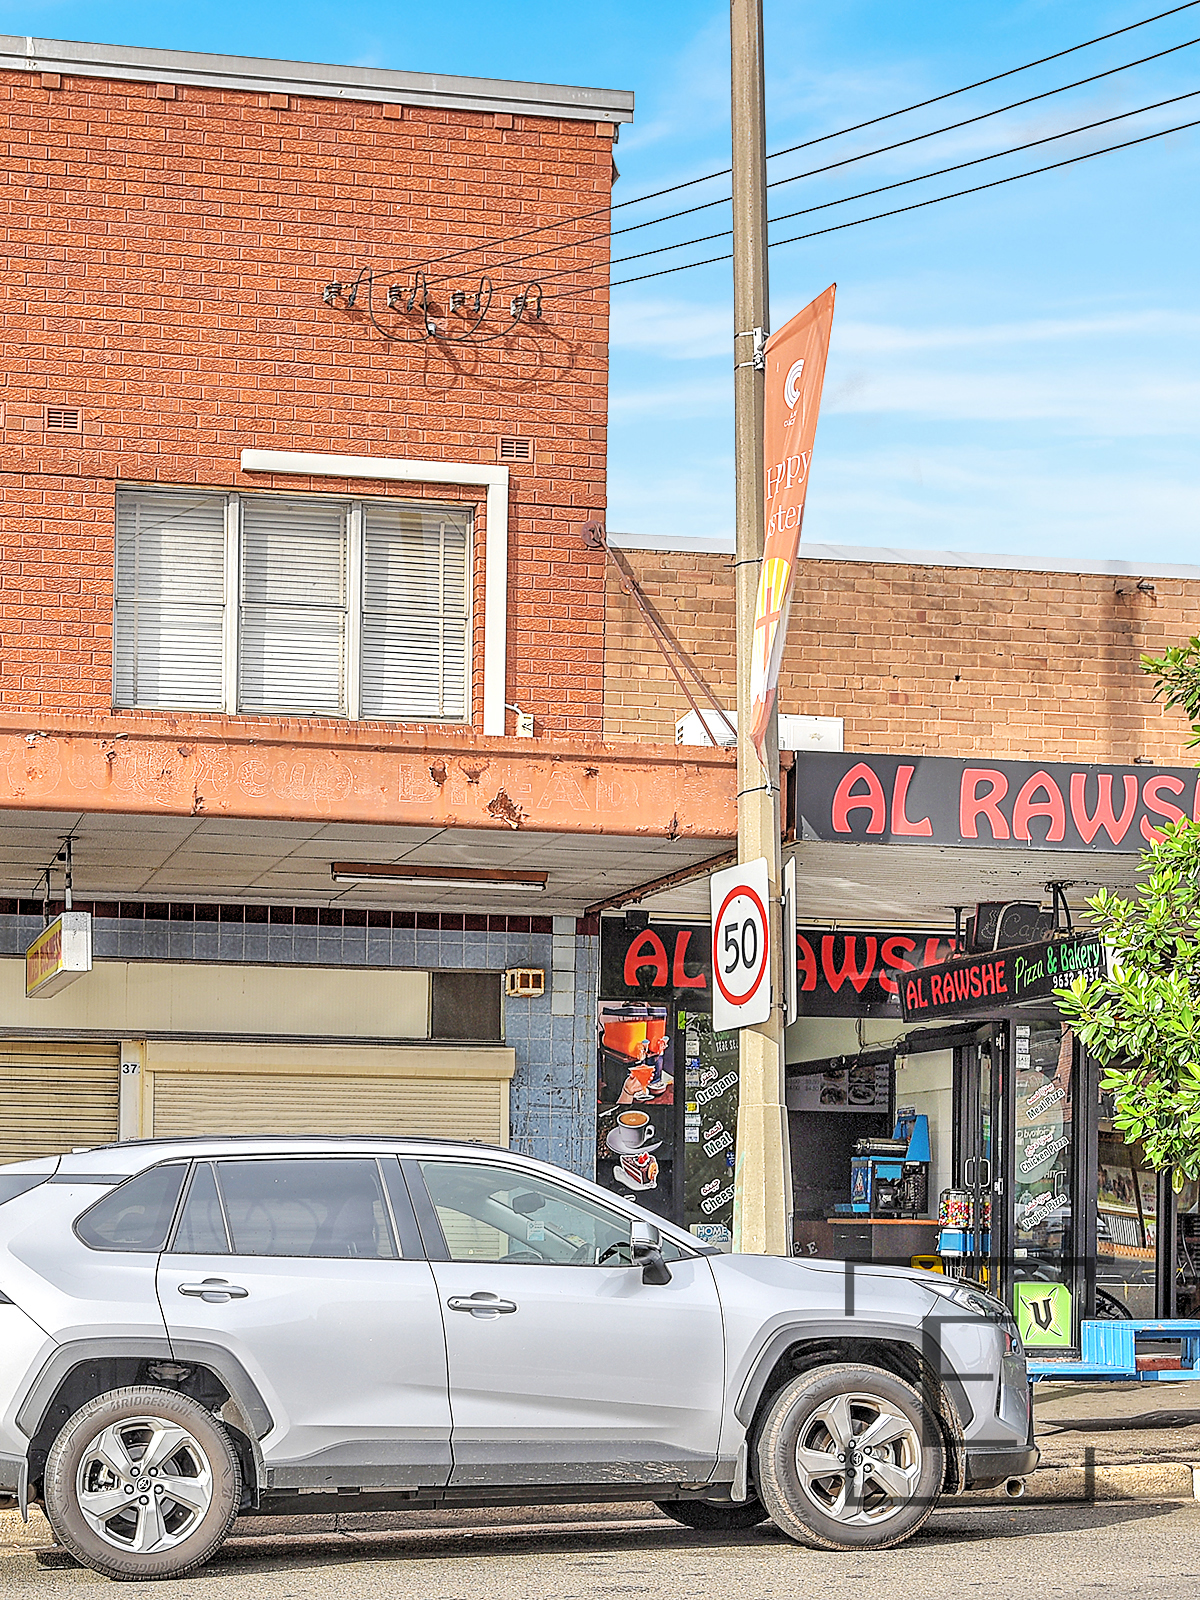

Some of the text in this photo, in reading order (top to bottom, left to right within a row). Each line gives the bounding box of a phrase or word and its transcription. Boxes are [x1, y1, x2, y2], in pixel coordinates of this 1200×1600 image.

[831, 762, 934, 837] AL
[624, 929, 707, 988] AL
[725, 917, 757, 974] 50
[906, 941, 1100, 1010] AL RAWSHE Pizza & Bakery
[696, 1072, 738, 1104] Oregano
[1045, 1089, 1064, 1106] Pizza
[704, 1132, 733, 1157] Meat
[1021, 1138, 1068, 1172] Chicken Pizza
[1022, 1196, 1066, 1229] Vegies Pizza
[696, 1225, 729, 1237] HOME
[109, 1396, 195, 1419] BRIDGESTONE
